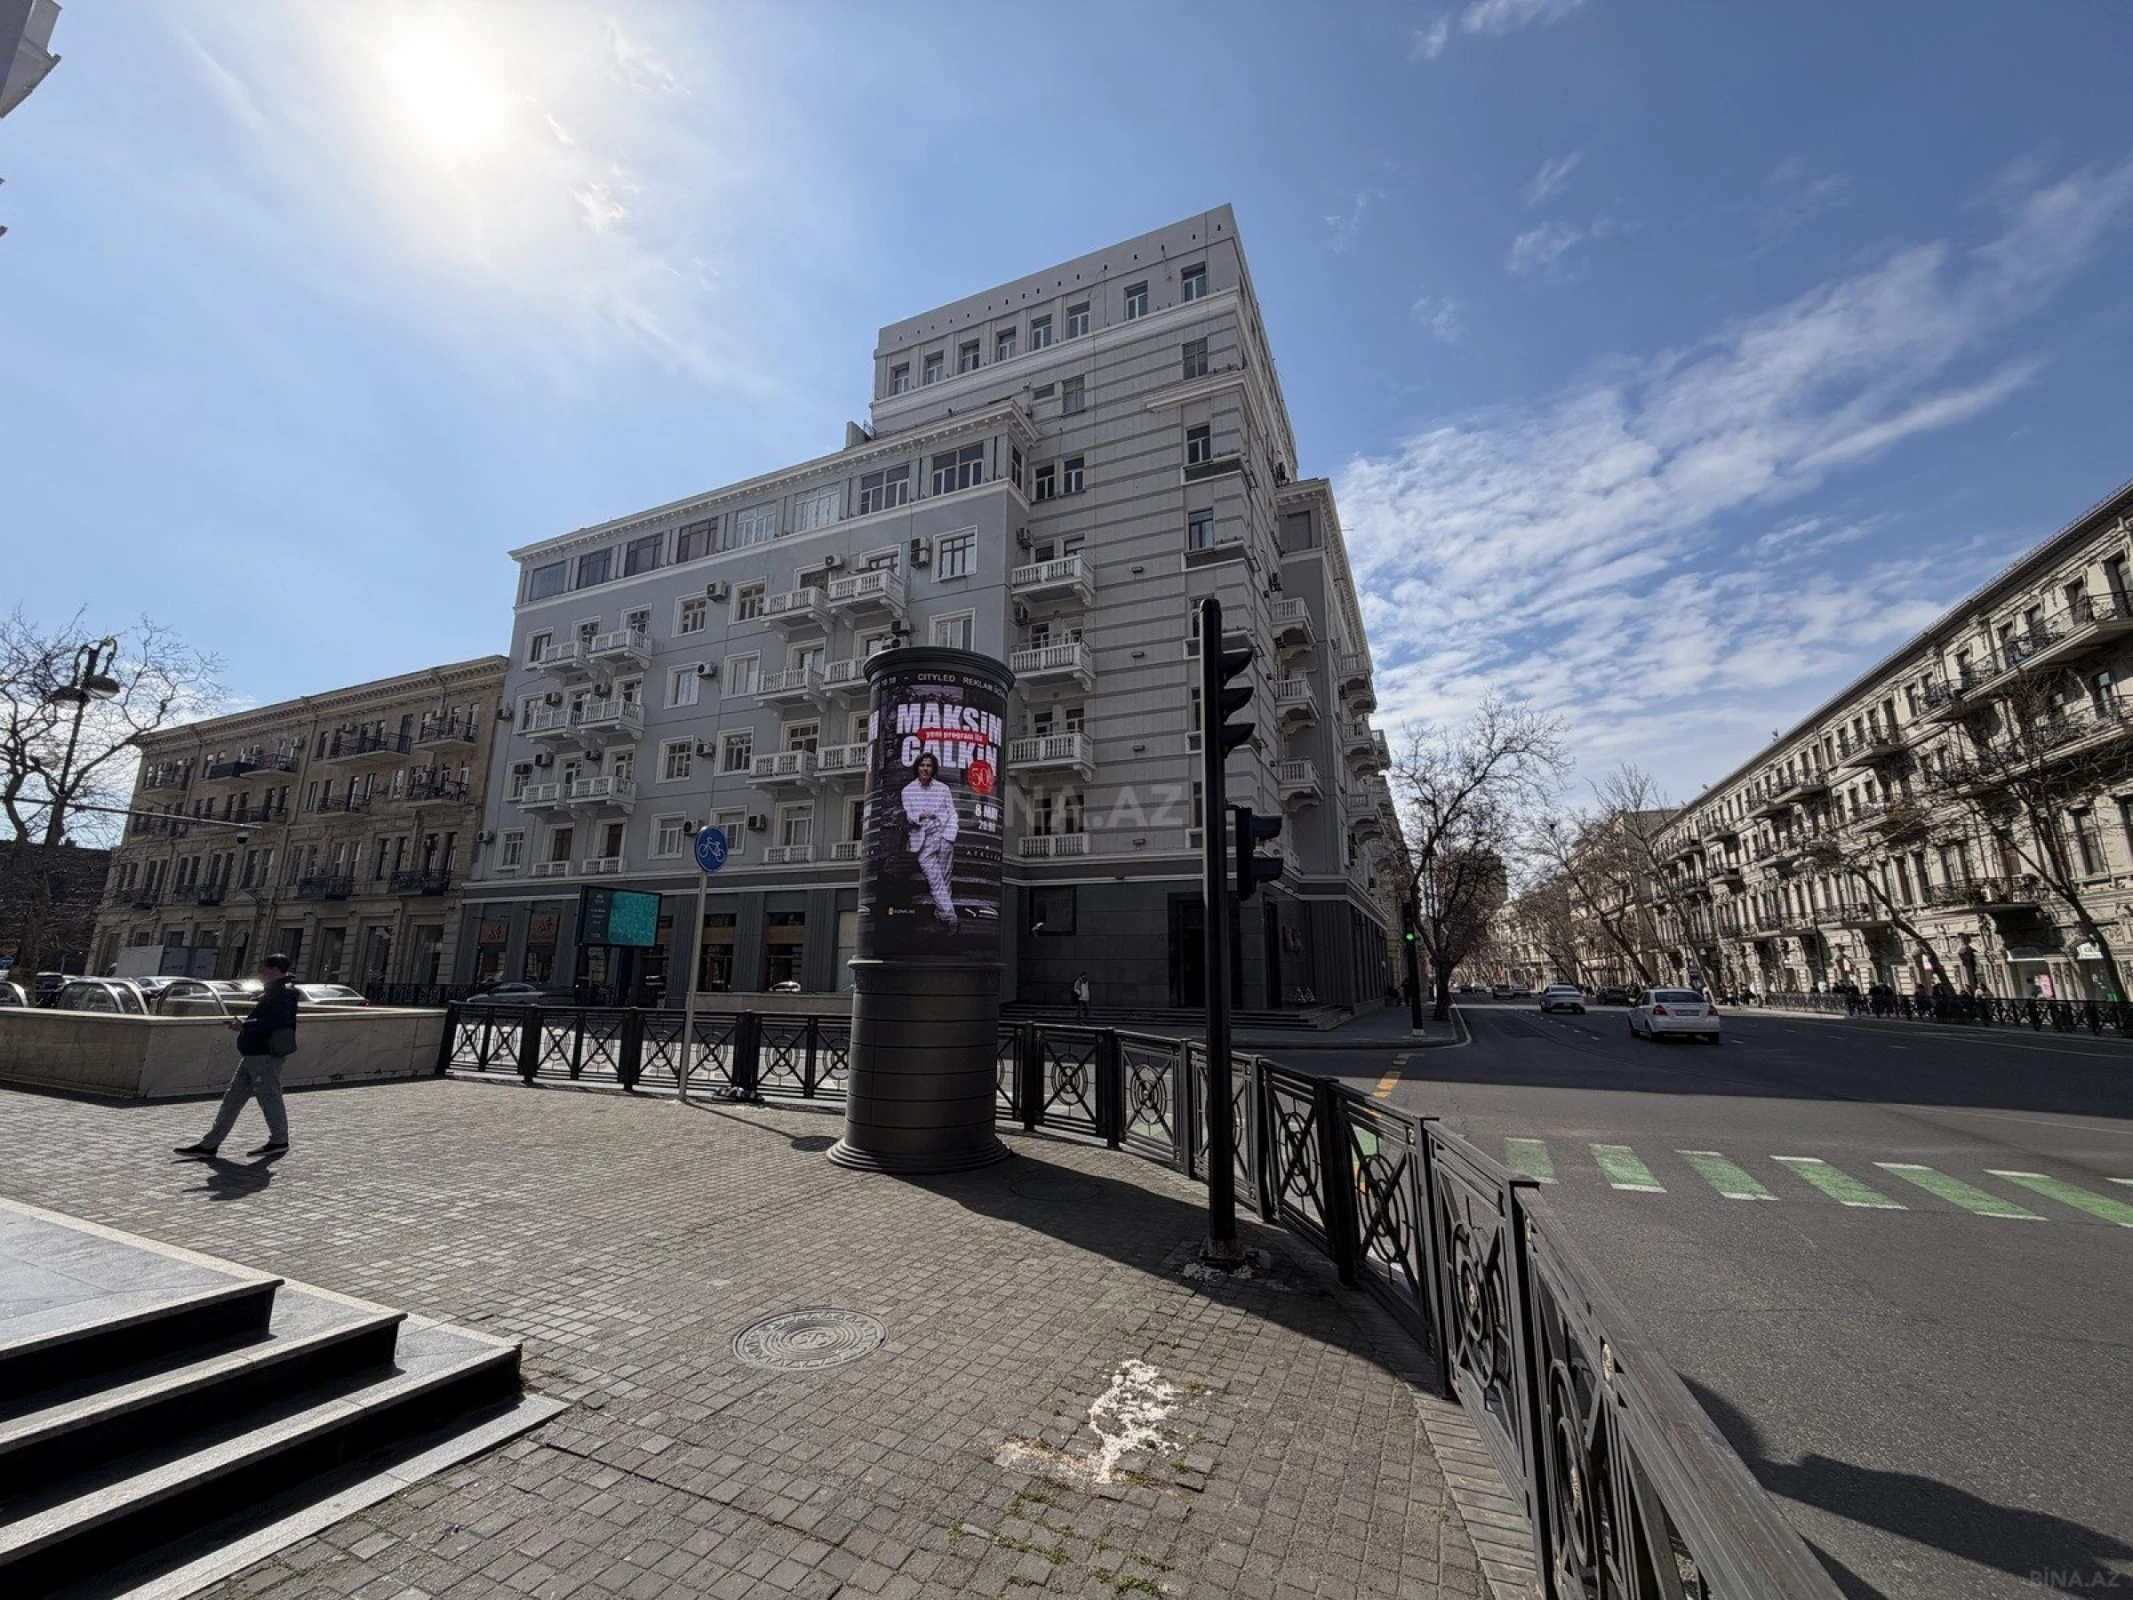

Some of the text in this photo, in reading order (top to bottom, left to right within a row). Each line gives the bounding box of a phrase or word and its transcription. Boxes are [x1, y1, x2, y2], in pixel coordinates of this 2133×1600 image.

[917, 673, 956, 682] CITYLED
[943, 731, 974, 741] program
[975, 803, 981, 817] 8
